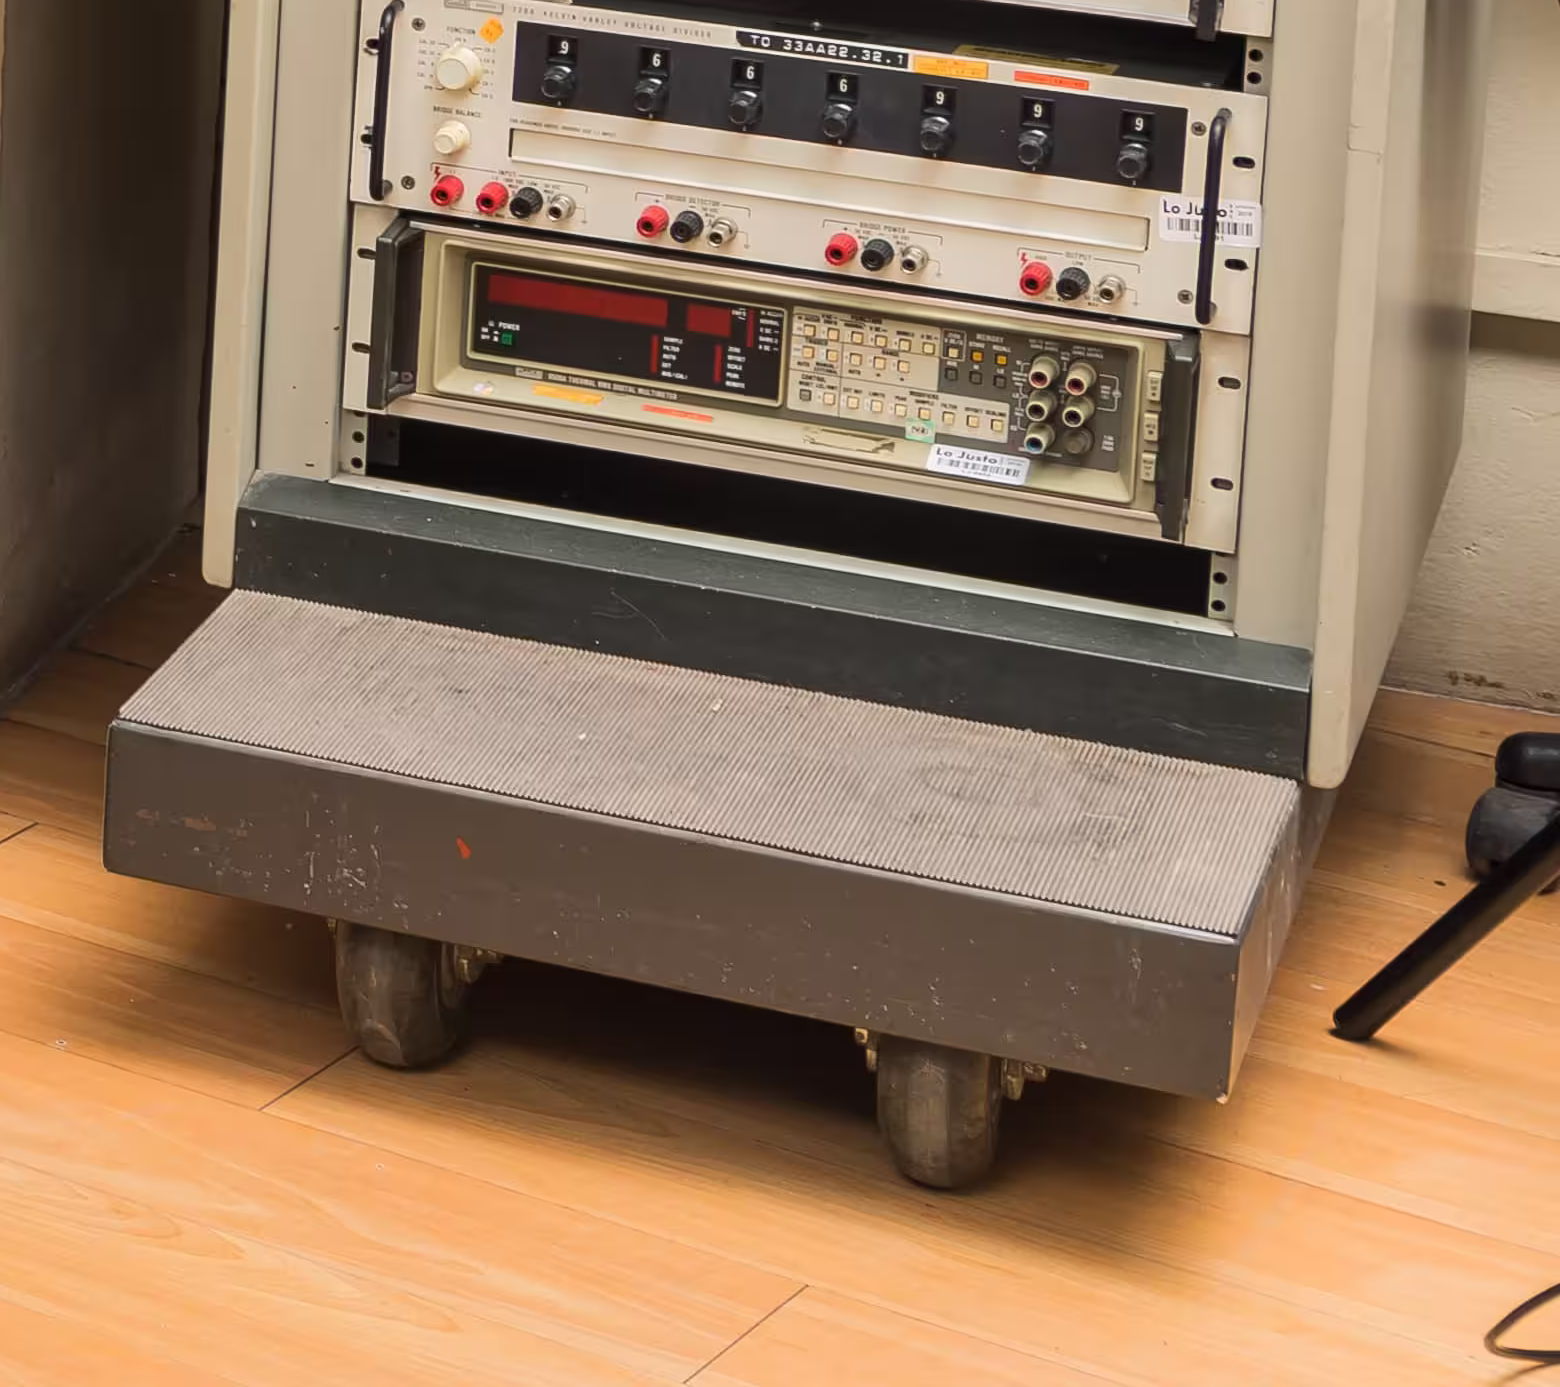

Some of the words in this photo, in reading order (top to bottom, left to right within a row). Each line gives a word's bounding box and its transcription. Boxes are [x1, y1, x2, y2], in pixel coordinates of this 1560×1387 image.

[445, 26, 477, 37] FUNCTION
[543, 10, 577, 22] KELVIN
[582, 14, 619, 28] VARLEY
[624, 20, 667, 33] VOLTAGE
[673, 26, 713, 39] DIVIDER
[559, 40, 570, 55] 9
[750, 34, 770, 48] TO
[783, 38, 905, 66] 33AA22.32.1
[652, 52, 662, 68] 6
[746, 65, 755, 80] 6
[839, 78, 848, 93] 6
[935, 91, 945, 106] 9
[455, 108, 482, 119] BALANCE
[1033, 103, 1043, 118] 9
[1135, 117, 1144, 131] 9
[1163, 199, 1181, 215] Lo
[1186, 201, 1228, 218] Juo
[1064, 251, 1093, 262] OUTPUT
[498, 320, 521, 332] POWER
[975, 333, 1005, 344] MEMORY
[612, 382, 637, 394] DIGITAL
[638, 386, 678, 401] MULTIMETER
[935, 446, 953, 459] Lo
[957, 449, 998, 465] Justo
